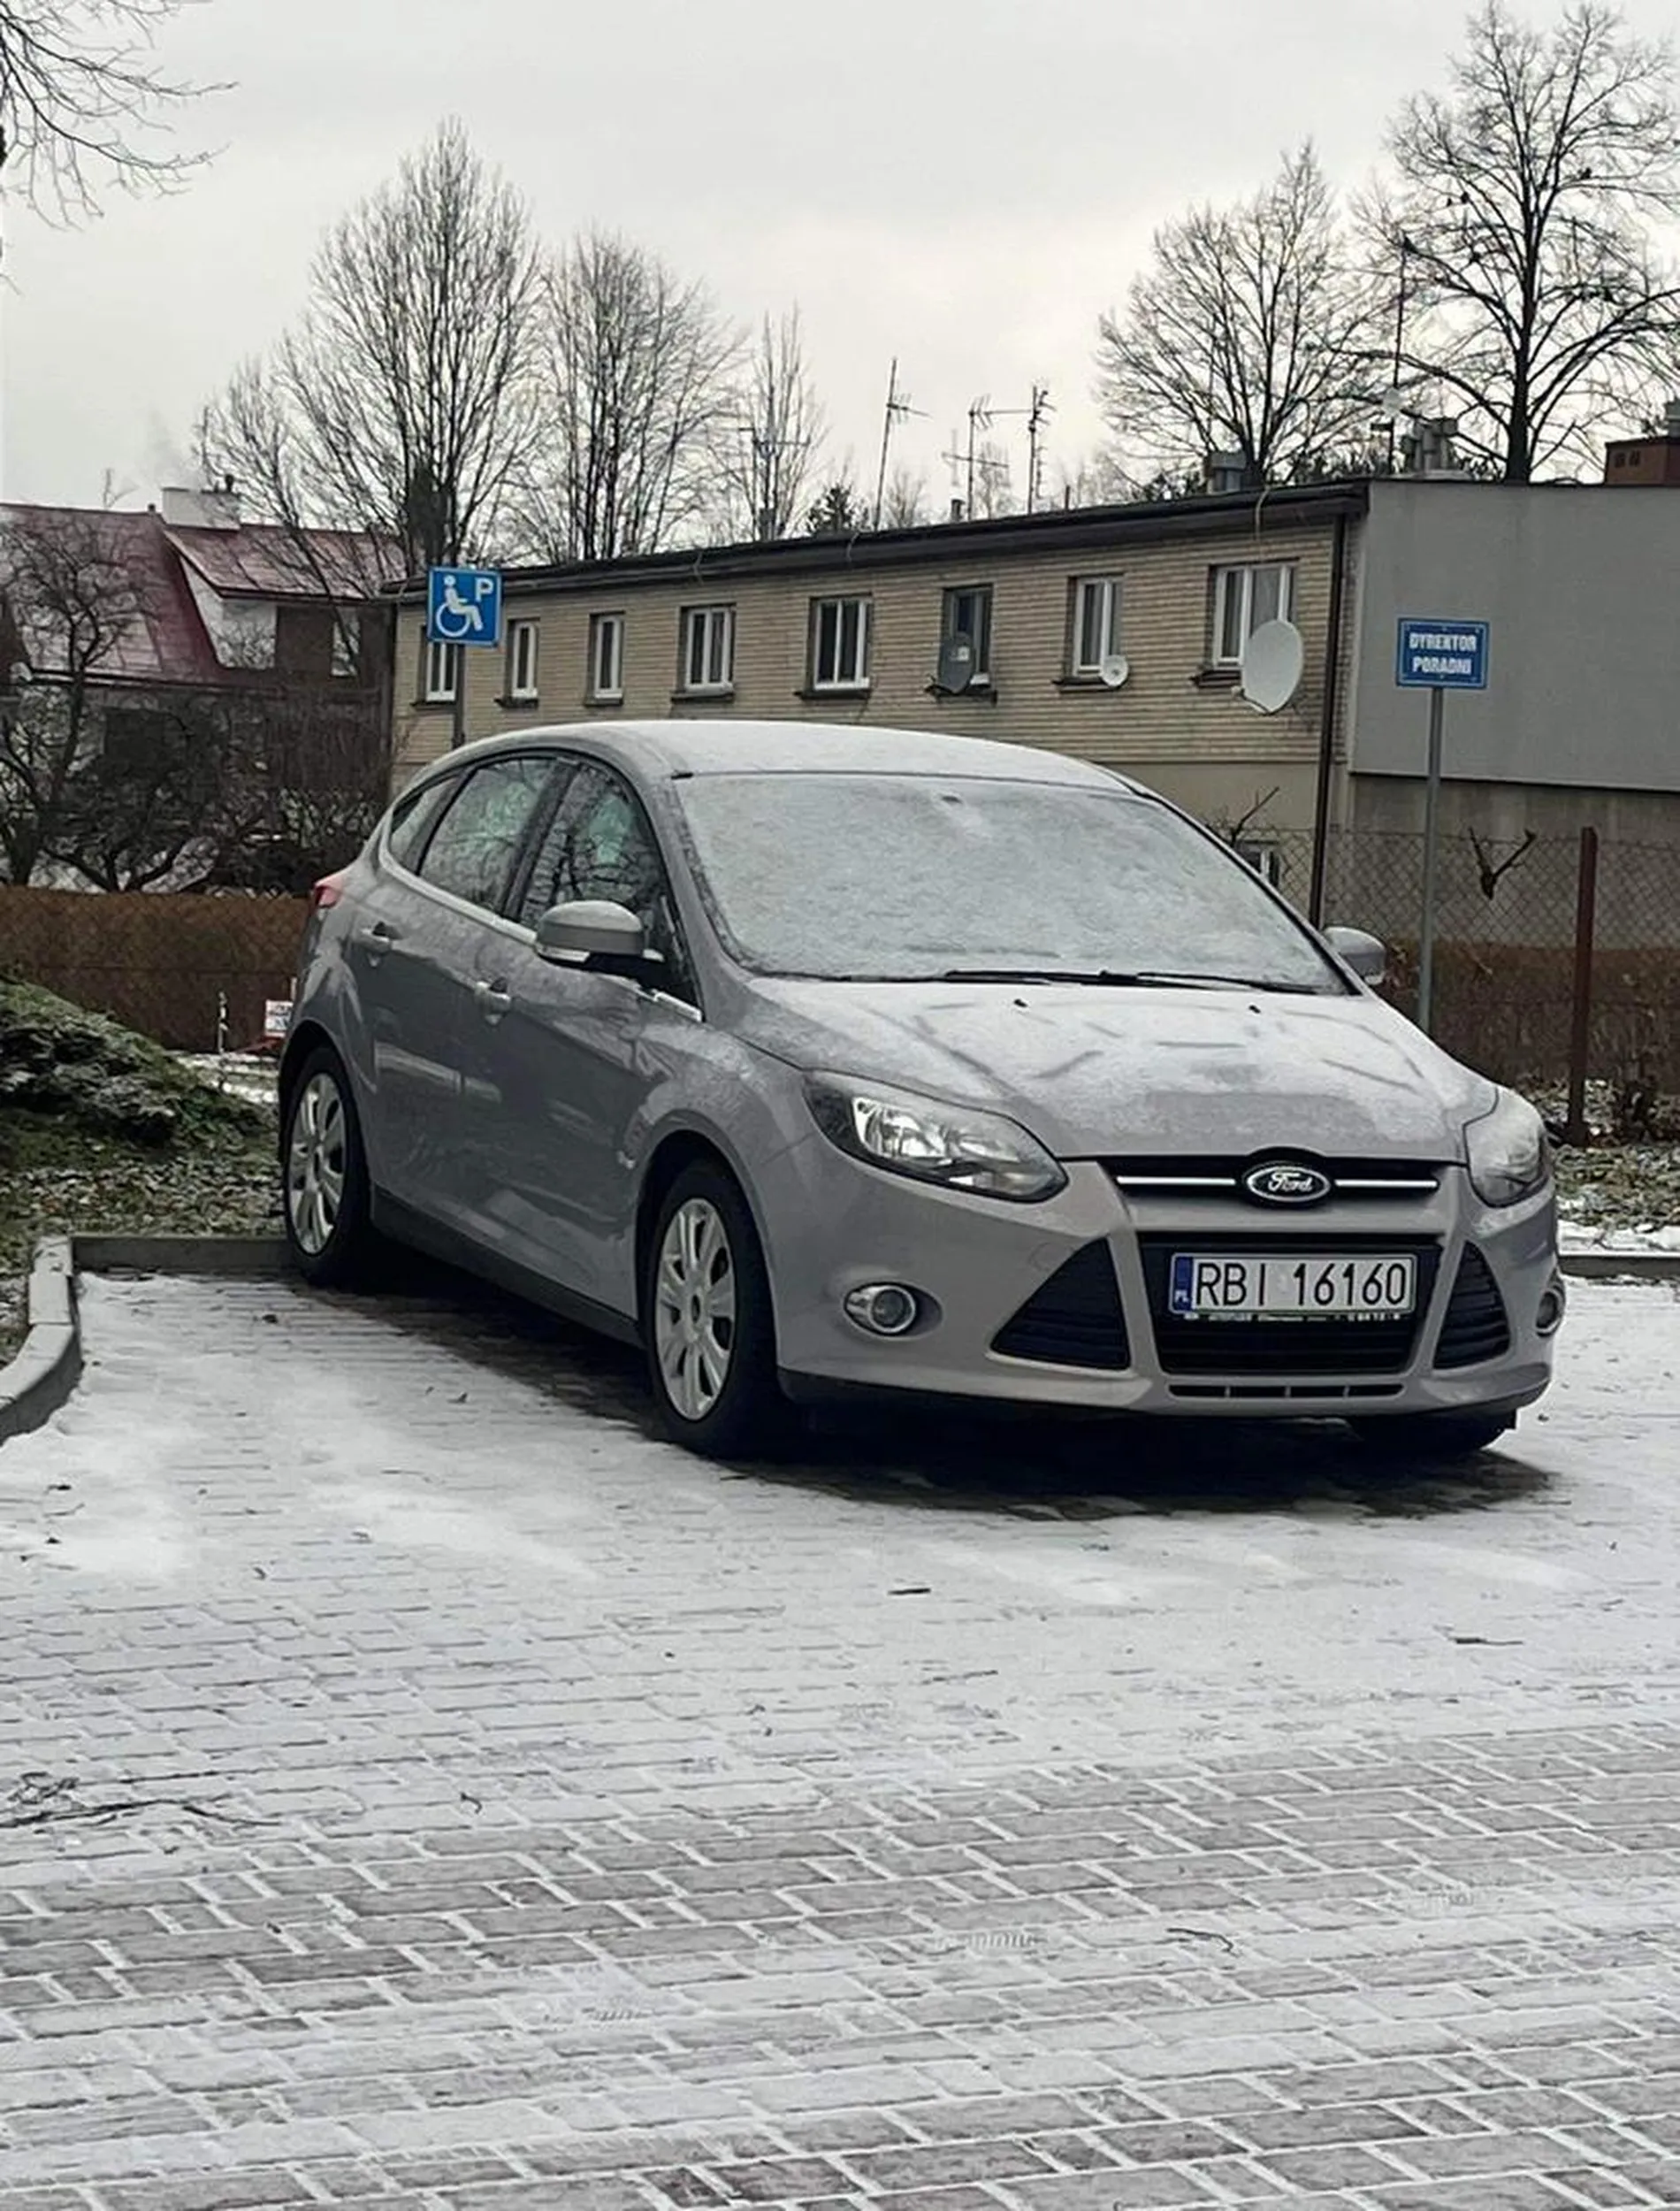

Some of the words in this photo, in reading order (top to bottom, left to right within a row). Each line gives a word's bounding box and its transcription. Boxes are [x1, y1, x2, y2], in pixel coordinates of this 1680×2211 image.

[475, 578, 494, 602] P
[1409, 632, 1477, 652] DYREKTOR
[1412, 656, 1472, 675] PORADNI
[1267, 1171, 1313, 1192] Ford
[1195, 1262, 1266, 1306] RBI
[1293, 1262, 1407, 1306] 16160
